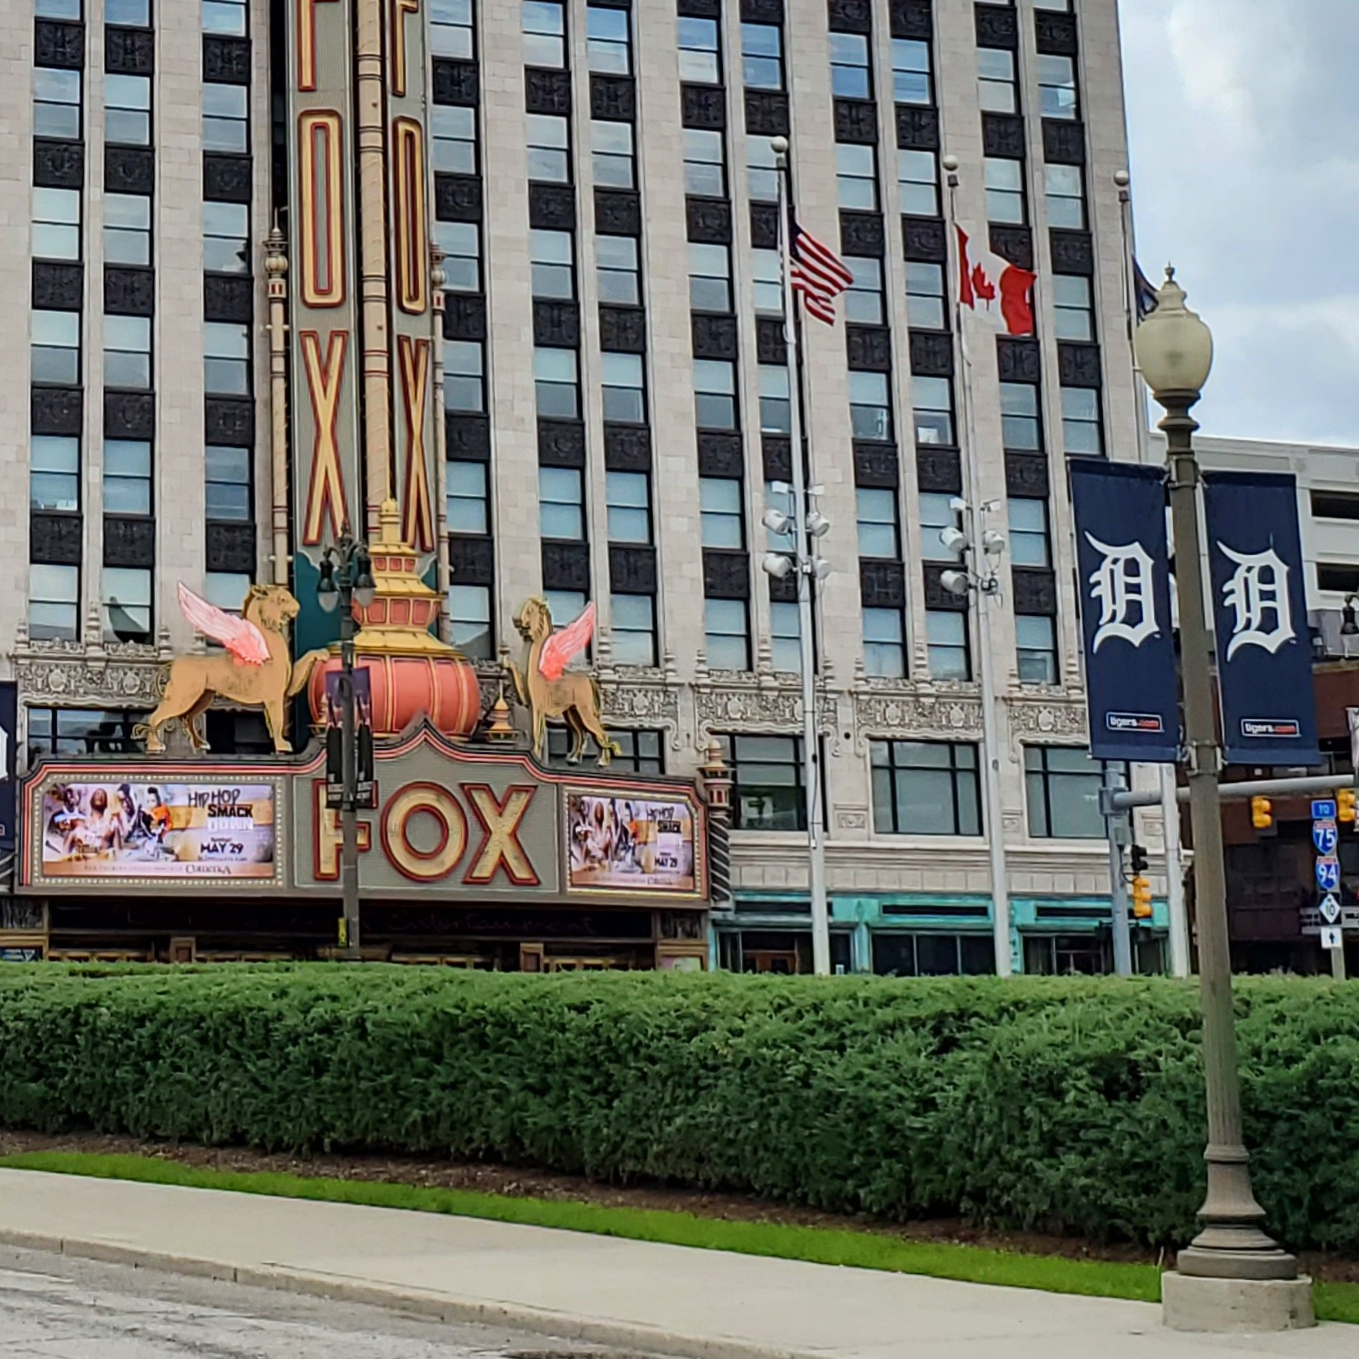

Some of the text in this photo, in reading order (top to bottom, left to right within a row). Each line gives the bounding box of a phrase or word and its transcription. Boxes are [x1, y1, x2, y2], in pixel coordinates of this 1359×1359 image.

[1084, 530, 1161, 655] D
[1216, 540, 1297, 662] D
[188, 788, 241, 809] HIP HOP
[207, 804, 253, 818] SMACK
[312, 778, 542, 886] FOX
[1316, 829, 1335, 847] 75
[200, 842, 244, 855] MAY 29
[1318, 866, 1337, 883] 94
